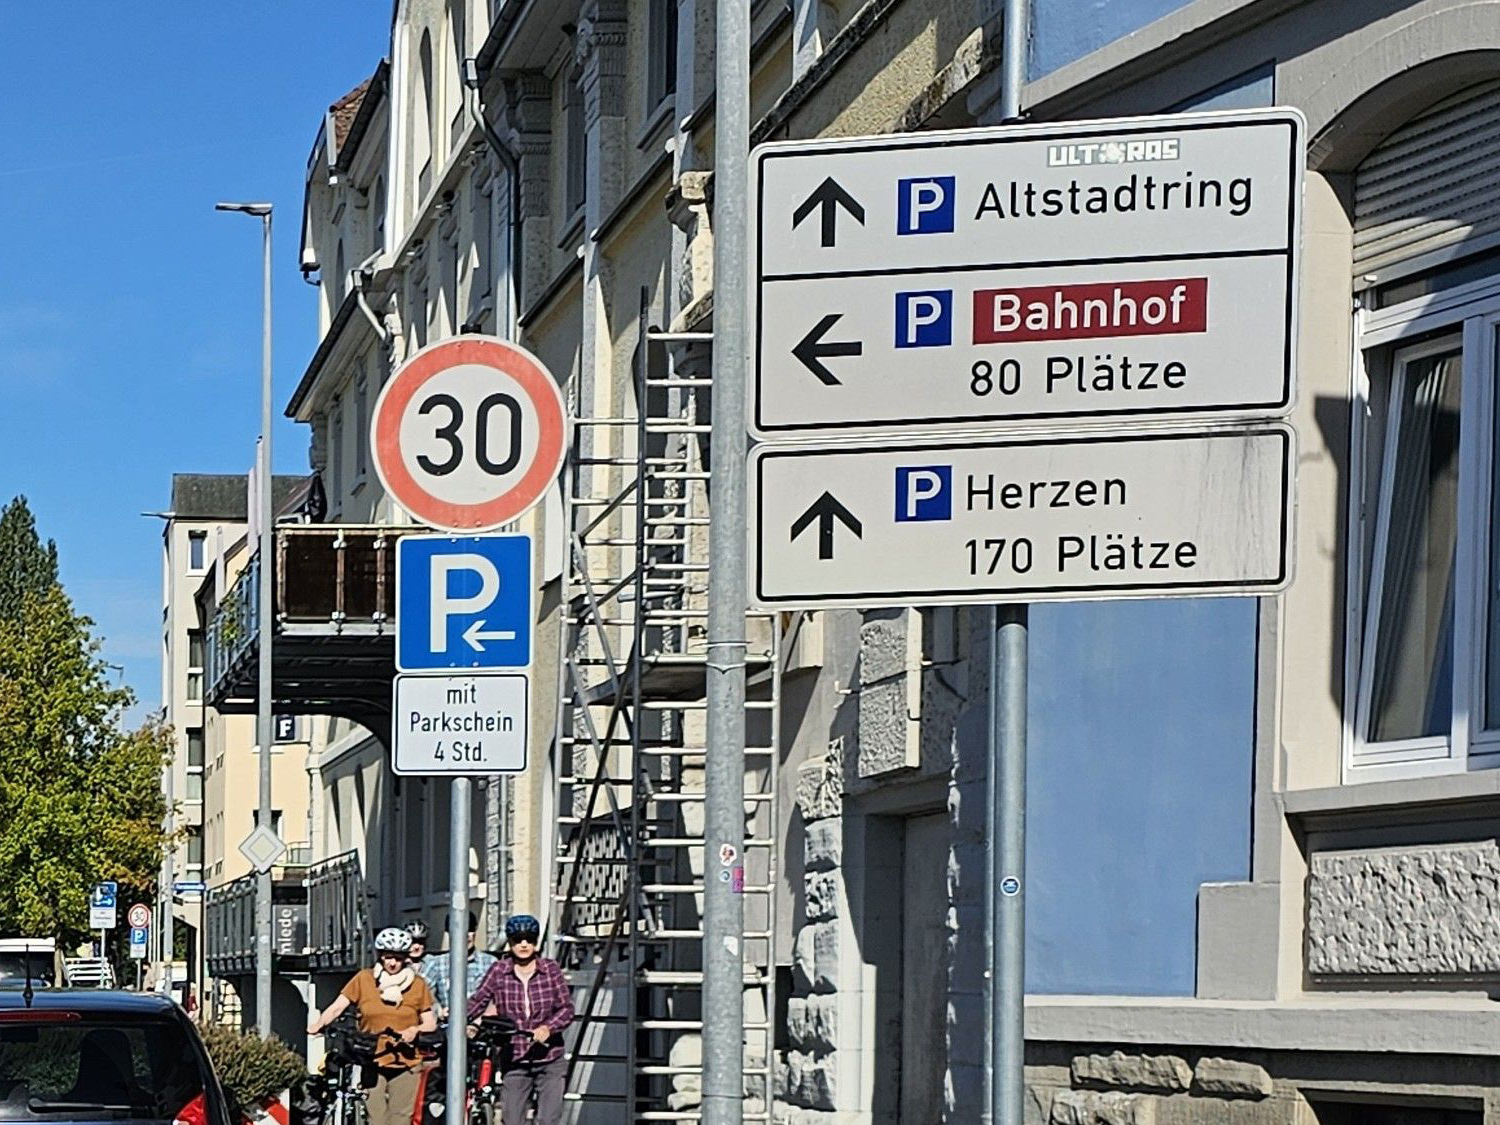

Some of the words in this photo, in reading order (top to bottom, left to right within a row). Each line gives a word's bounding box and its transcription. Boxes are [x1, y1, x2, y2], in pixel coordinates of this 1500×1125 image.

[909, 182, 945, 231] P
[974, 171, 1252, 220] Altstadtring
[906, 295, 942, 344] P
[992, 285, 1187, 333] Bahnhof
[970, 358, 1021, 397] 80
[1046, 354, 1187, 394] Plätze
[416, 392, 523, 477] 30
[906, 470, 942, 518] P
[967, 473, 1126, 511] Herzen
[964, 537, 1033, 576] 170
[1057, 533, 1198, 573] Plätze
[430, 553, 500, 653] P
[446, 682, 477, 705] mit
[279, 719, 293, 738] F
[410, 710, 513, 733] Parkschein
[434, 741, 445, 762] 4
[452, 741, 488, 762] Std.
[134, 930, 144, 943] P
